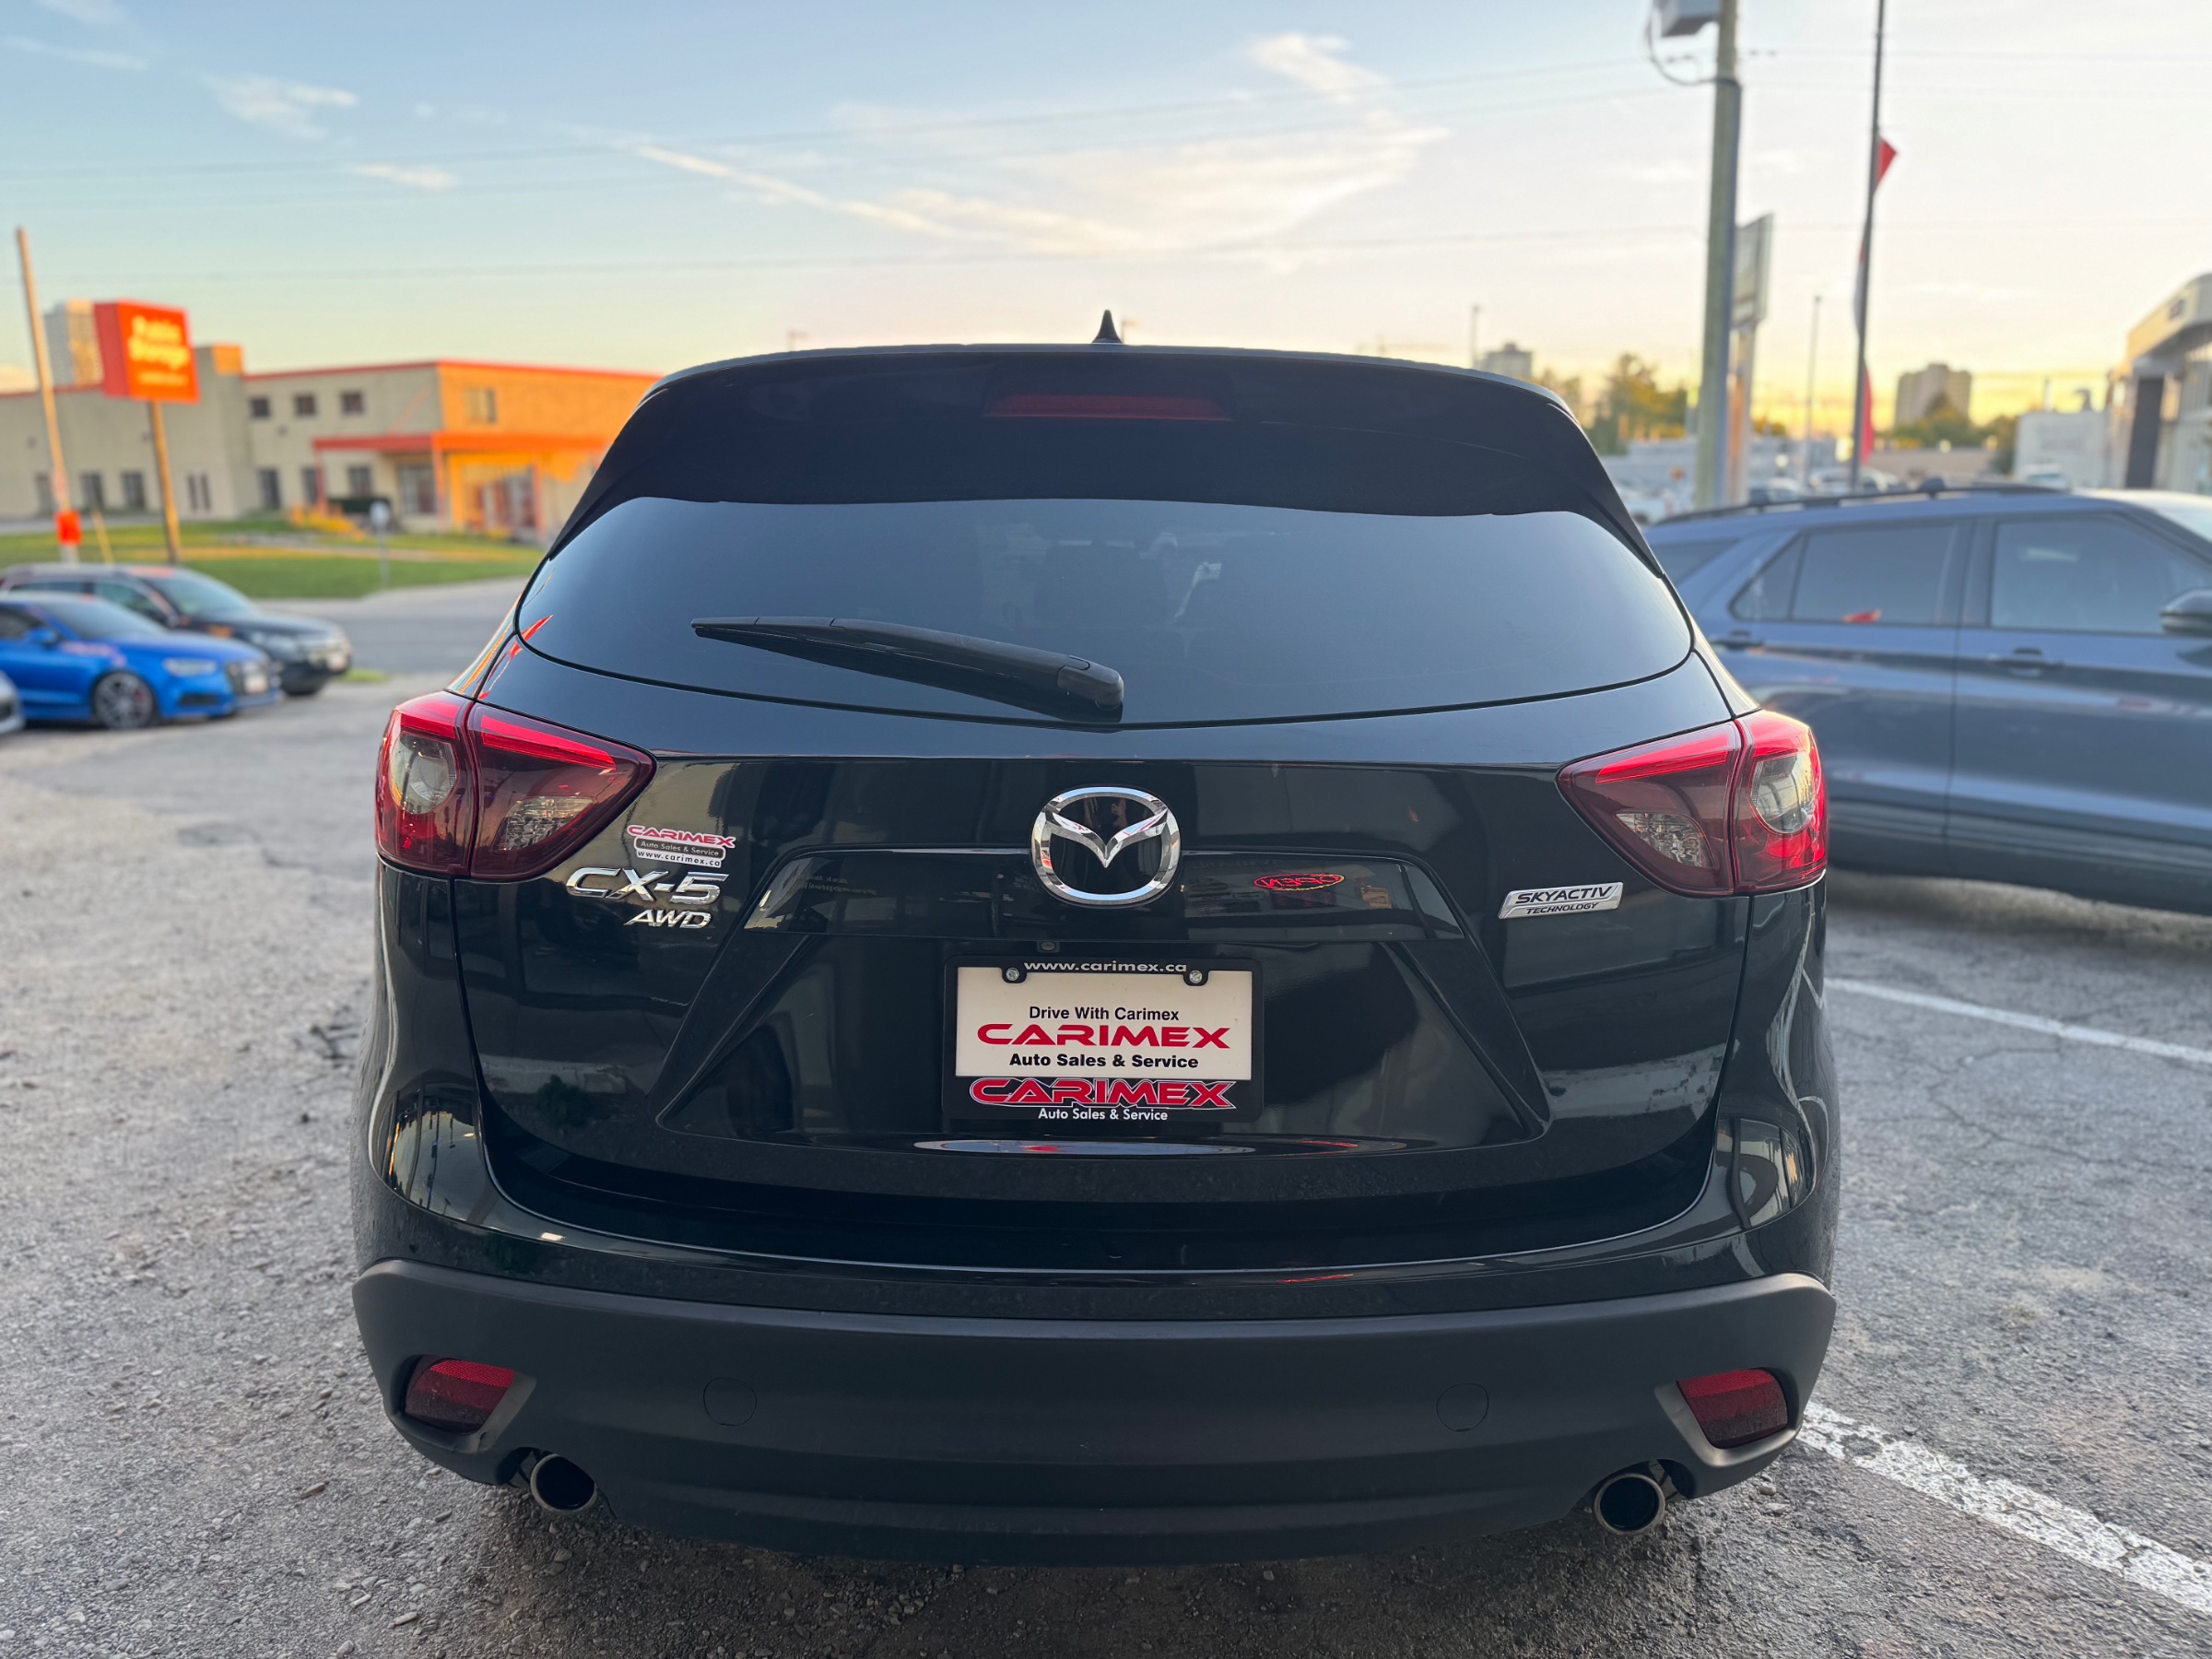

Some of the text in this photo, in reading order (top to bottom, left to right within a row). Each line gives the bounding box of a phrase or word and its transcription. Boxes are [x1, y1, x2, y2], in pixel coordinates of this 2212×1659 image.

[628, 826, 735, 847] CARIMEX
[641, 841, 659, 849] Auto
[661, 843, 681, 852] Sales
[691, 847, 720, 857] Service
[638, 851, 721, 866] www.carimex.ca
[566, 866, 729, 905] CX-5
[1515, 886, 1612, 904] SKYACTIV
[1526, 902, 1599, 914] TECHNOLOGY
[623, 909, 712, 929] AWD
[1024, 960, 1187, 972] www.carimex.ca
[1029, 1006, 1180, 1021] Drive With Carimex
[977, 1024, 1230, 1049] CARIMEX
[1009, 1053, 1199, 1068] Auto Sales & Service
[971, 1078, 1235, 1109] CARIMEX
[1038, 1108, 1169, 1121] Auto Sales & Service
